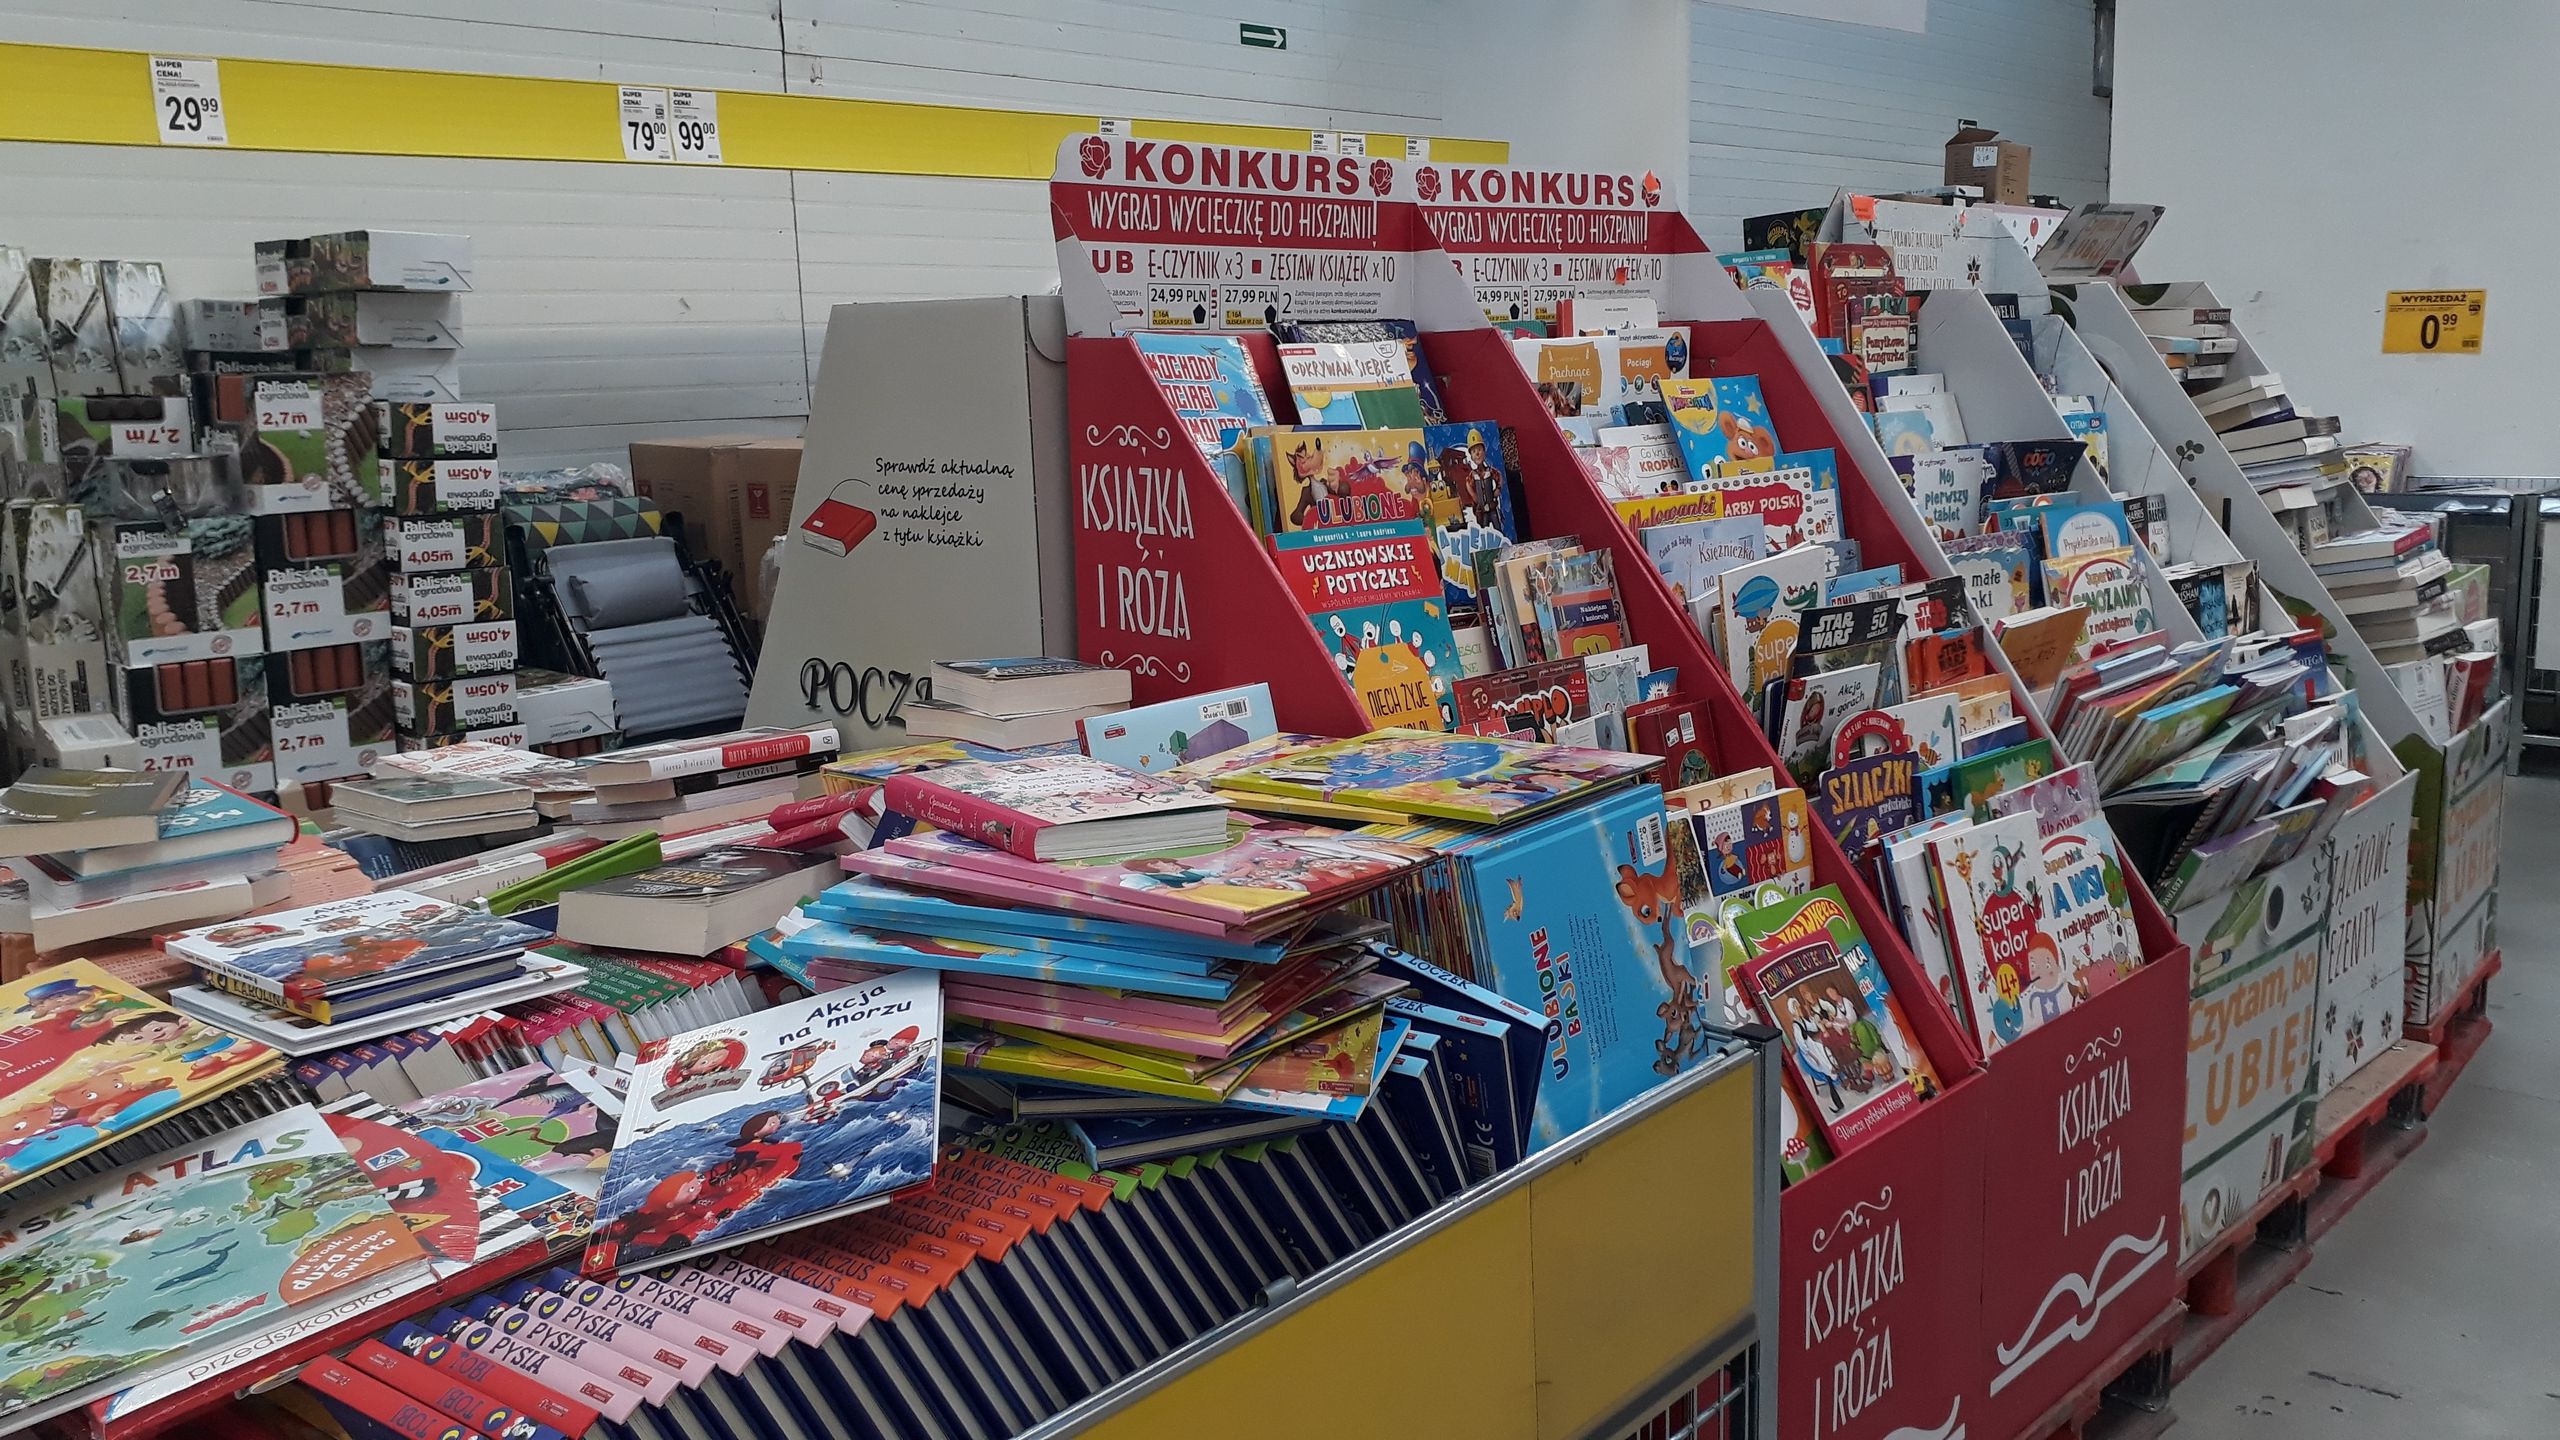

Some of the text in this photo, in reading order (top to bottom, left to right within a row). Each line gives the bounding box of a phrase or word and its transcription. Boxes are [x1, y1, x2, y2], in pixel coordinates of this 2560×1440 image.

[155, 60, 183, 69] SUPER
[156, 70, 182, 78] CENA!
[165, 96, 219, 132] 29 99
[627, 121, 667, 151] 79 00
[678, 121, 716, 151] 99 00
[1125, 141, 1360, 195] KONKURS
[1450, 168, 1635, 207] KONKURS
[1087, 190, 1379, 248] WYGRAJ WYCIECZKĘ DO HISZPANII!
[1424, 210, 1649, 252] WYGRAJ WYCIECZKĘ DO HISZPANII!
[1148, 249, 1369, 287] E-CZYTNIK ZESTAW KSIĄŻEK
[1473, 257, 1602, 282] E-CZYTNIK ZESTAW
[1150, 288, 1207, 304] 24,99 PLN
[1225, 289, 1256, 304] 27,99
[1258, 290, 1278, 305] PLN
[1281, 292, 1293, 314] 2
[1476, 290, 1520, 303] 24,99 PLN
[1534, 289, 1558, 302] 27,99
[2400, 292, 2467, 304] WYPRZEDAŻ
[2420, 313, 2458, 350] 0 99
[1548, 365, 1593, 379] Pachnące
[1626, 356, 1653, 369] Pociągi
[257, 380, 309, 395] Palisada
[445, 410, 490, 424] 4,05m
[445, 442, 493, 454] Palisada
[447, 466, 492, 480] 4,05m
[875, 457, 1015, 479] Sprawdź aktualną
[1938, 467, 1955, 487] Mój
[447, 498, 495, 510] Palisada
[878, 483, 985, 504] cenę sprzedaży
[1080, 446, 1195, 550] KSIĄŻKA
[1759, 495, 1801, 513] POLSKI
[1924, 488, 1969, 510] pierwszy
[880, 505, 963, 525] na naklejce
[1317, 491, 1406, 526] ULUBIONE
[1627, 494, 1717, 533] Malowanki
[1933, 506, 1961, 522] tablet
[403, 519, 453, 533] Palisada
[883, 531, 891, 542] z
[927, 529, 984, 547] książki
[407, 550, 454, 565] 4,05m
[1302, 542, 1414, 574] UCZNIOWSKIE
[267, 566, 328, 584] Palisada
[412, 574, 462, 588] Palisada
[1325, 566, 1411, 596] POTYCZKI
[1702, 575, 1716, 590] na
[1971, 570, 2002, 587] małe
[1097, 550, 1192, 641] I RÓŻA
[416, 604, 462, 619] 4,05m
[1818, 611, 1855, 628] STAR
[1870, 613, 1889, 629] 50
[466, 626, 511, 643] 4,05m
[1810, 629, 1854, 651] WARS
[466, 658, 515, 674] Palisada
[465, 680, 510, 697] 4,05m
[1366, 680, 1431, 718] NIECH ŻYJE
[1837, 680, 1862, 697] Akcja
[273, 700, 333, 719] Palisada
[465, 711, 514, 726] Palisada
[137, 718, 204, 738] Palisada
[1827, 760, 1913, 816] SZLACZKI
[2068, 865, 2107, 908] WSI
[302, 899, 412, 923] na morzu
[312, 898, 372, 916] Akcja
[1983, 900, 2027, 935] super
[2062, 905, 2110, 940] naklejkami
[1990, 928, 2029, 962] kolor
[1407, 956, 1473, 991] LOCZEK
[2293, 950, 2317, 998] bo
[805, 983, 887, 1024] Akcja
[1528, 925, 1571, 1082] ULUBIONE
[1555, 951, 1583, 1038] BAJKI
[778, 998, 913, 1047] na morzu
[2058, 1052, 2132, 1154] KSIĄŻKA
[120, 1128, 312, 1198] ATLAS
[1001, 1146, 1067, 1175] BARTEK
[2063, 1135, 2122, 1237] I RÓŻA
[291, 1230, 388, 1291] duża mapa
[308, 1235, 354, 1263] środku
[331, 1237, 398, 1279] świata
[681, 1270, 742, 1305] PYSIA
[719, 1259, 781, 1294] PYSIA
[1804, 1218, 1905, 1351] KSIĄŻKA
[601, 1294, 663, 1330] PYSIA
[638, 1280, 701, 1316] PYSIA
[187, 1285, 394, 1382] przedszkolaka
[561, 1305, 624, 1343] PYSIA
[525, 1321, 588, 1360] PYSIA
[448, 1350, 496, 1383] TOBI
[488, 1336, 551, 1376] PYSIA
[1813, 1315, 1894, 1440] I RÓŻA
[437, 1386, 486, 1421] TOBI
[390, 1403, 438, 1439] TOBI
